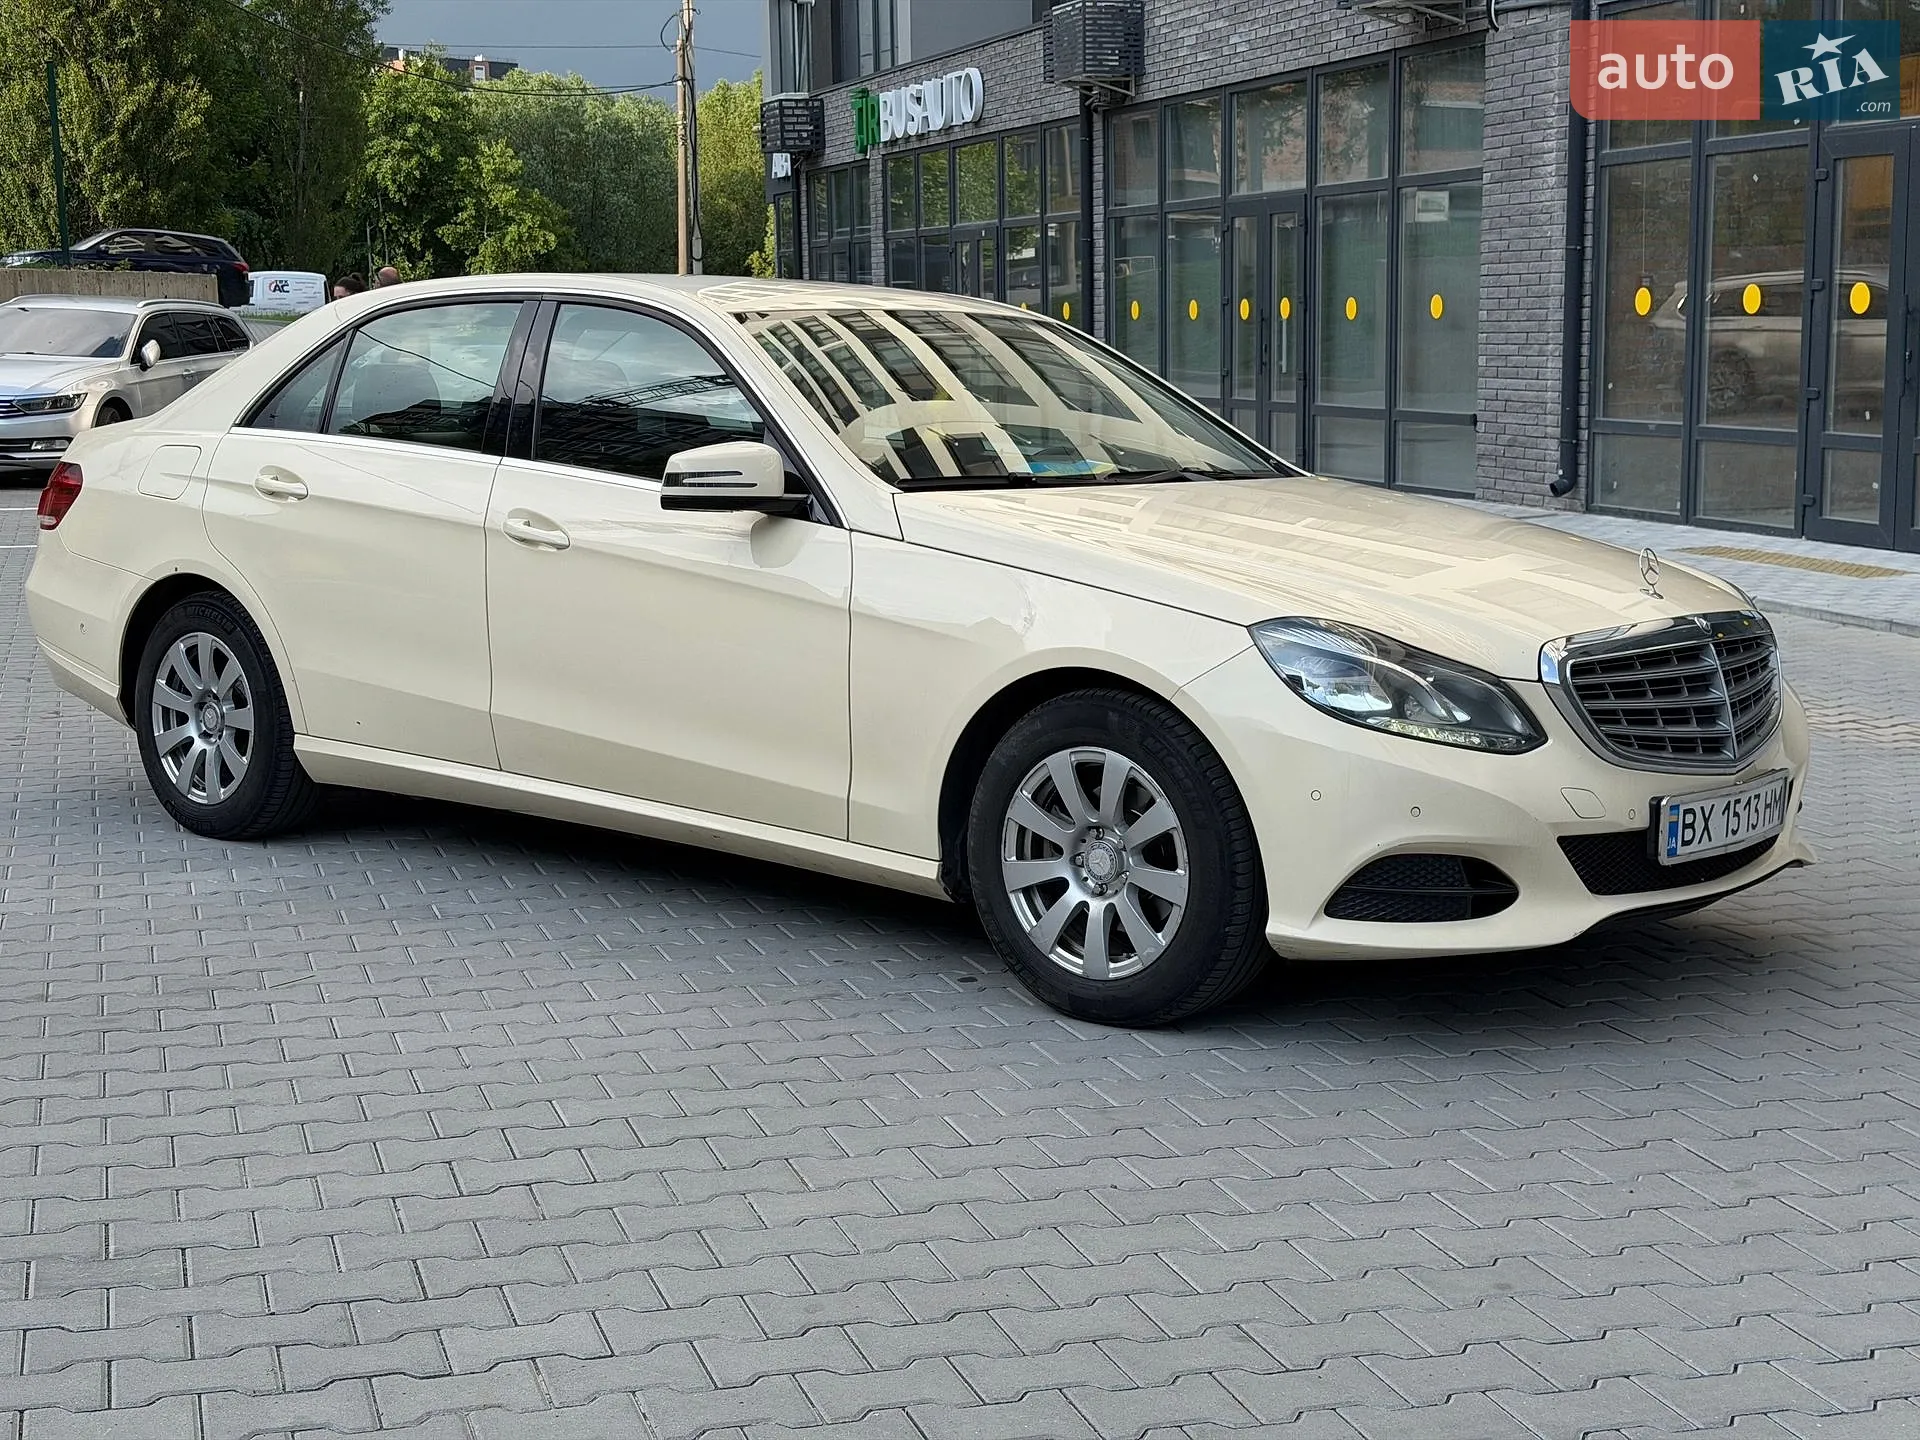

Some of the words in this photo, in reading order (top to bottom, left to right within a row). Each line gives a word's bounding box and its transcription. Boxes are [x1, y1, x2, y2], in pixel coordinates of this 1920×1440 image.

[1681, 803, 1715, 847] BX
[1721, 793, 1761, 838] 1513
[1763, 778, 1788, 828] HM
